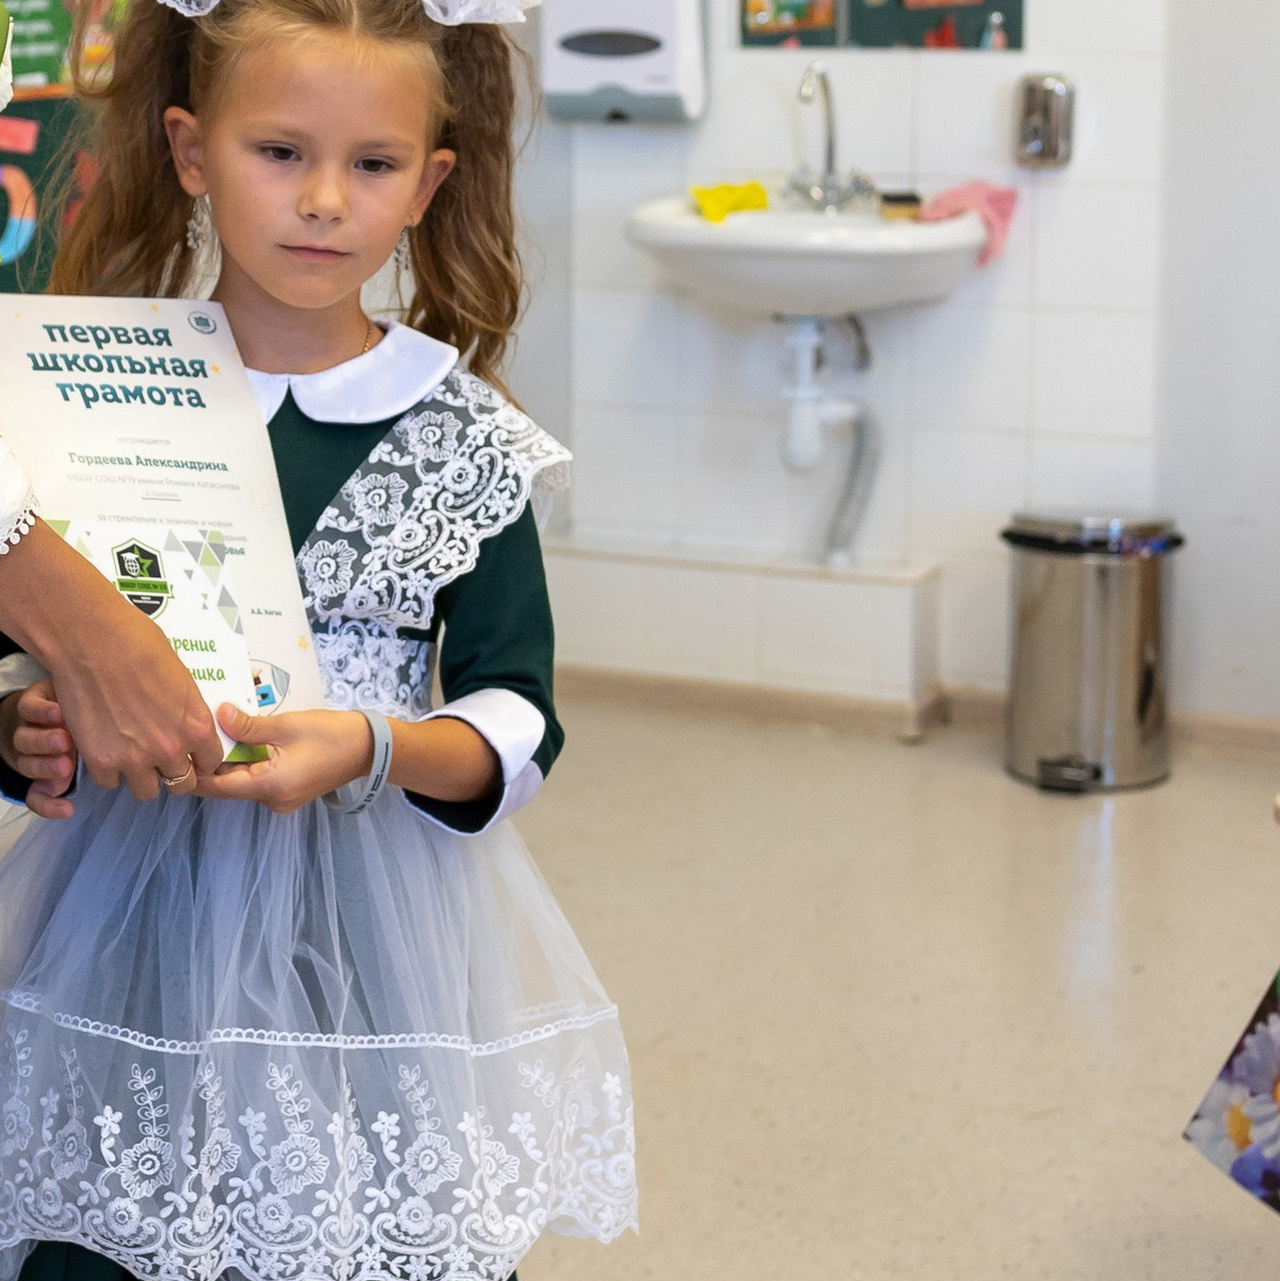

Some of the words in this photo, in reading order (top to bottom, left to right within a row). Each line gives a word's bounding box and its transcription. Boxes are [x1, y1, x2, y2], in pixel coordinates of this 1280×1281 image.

[42, 324, 173, 350] первая
[26, 352, 208, 378] школьная
[55, 382, 207, 409] грамота
[68, 452, 133, 468] Гордеева
[135, 455, 229, 472] Александрина
